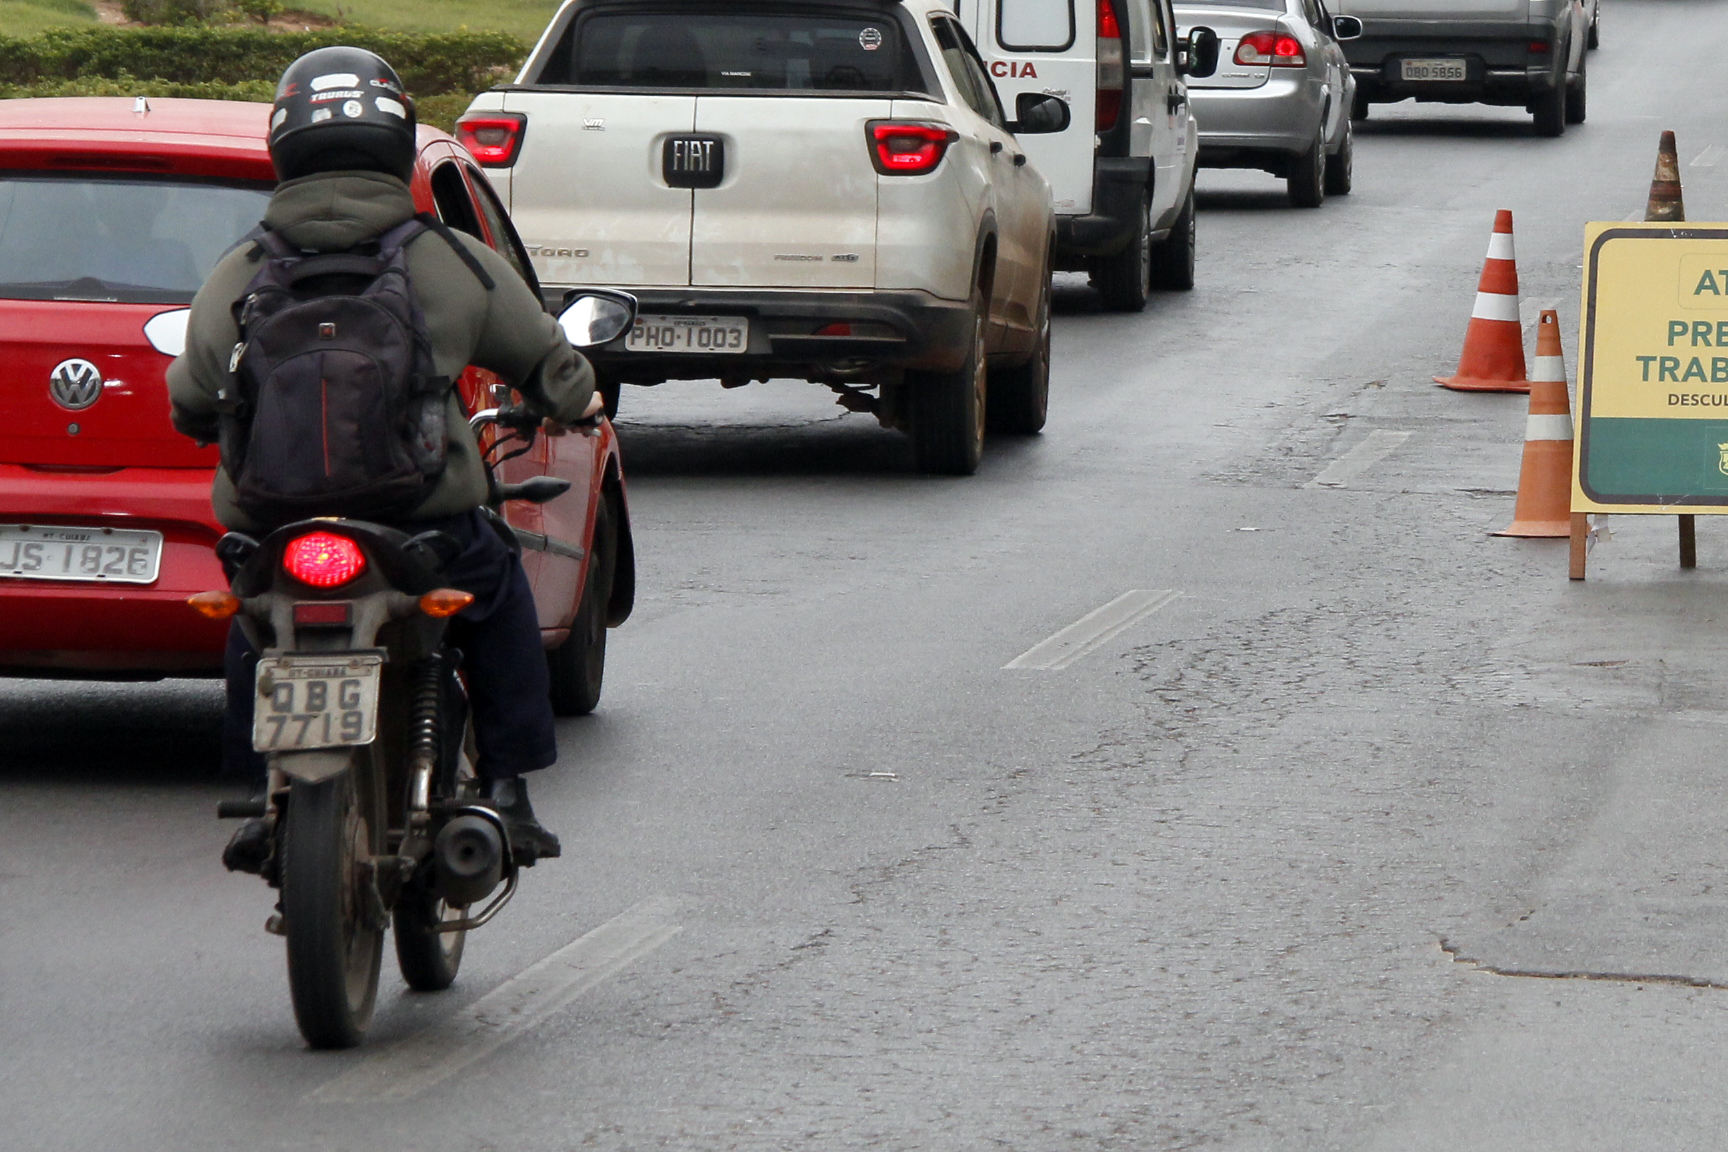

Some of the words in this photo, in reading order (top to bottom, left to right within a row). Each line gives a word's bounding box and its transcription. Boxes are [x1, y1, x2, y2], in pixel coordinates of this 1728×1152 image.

[985, 61, 1038, 78] CIA
[672, 140, 714, 172] FIAT
[266, 711, 363, 748] 7719
